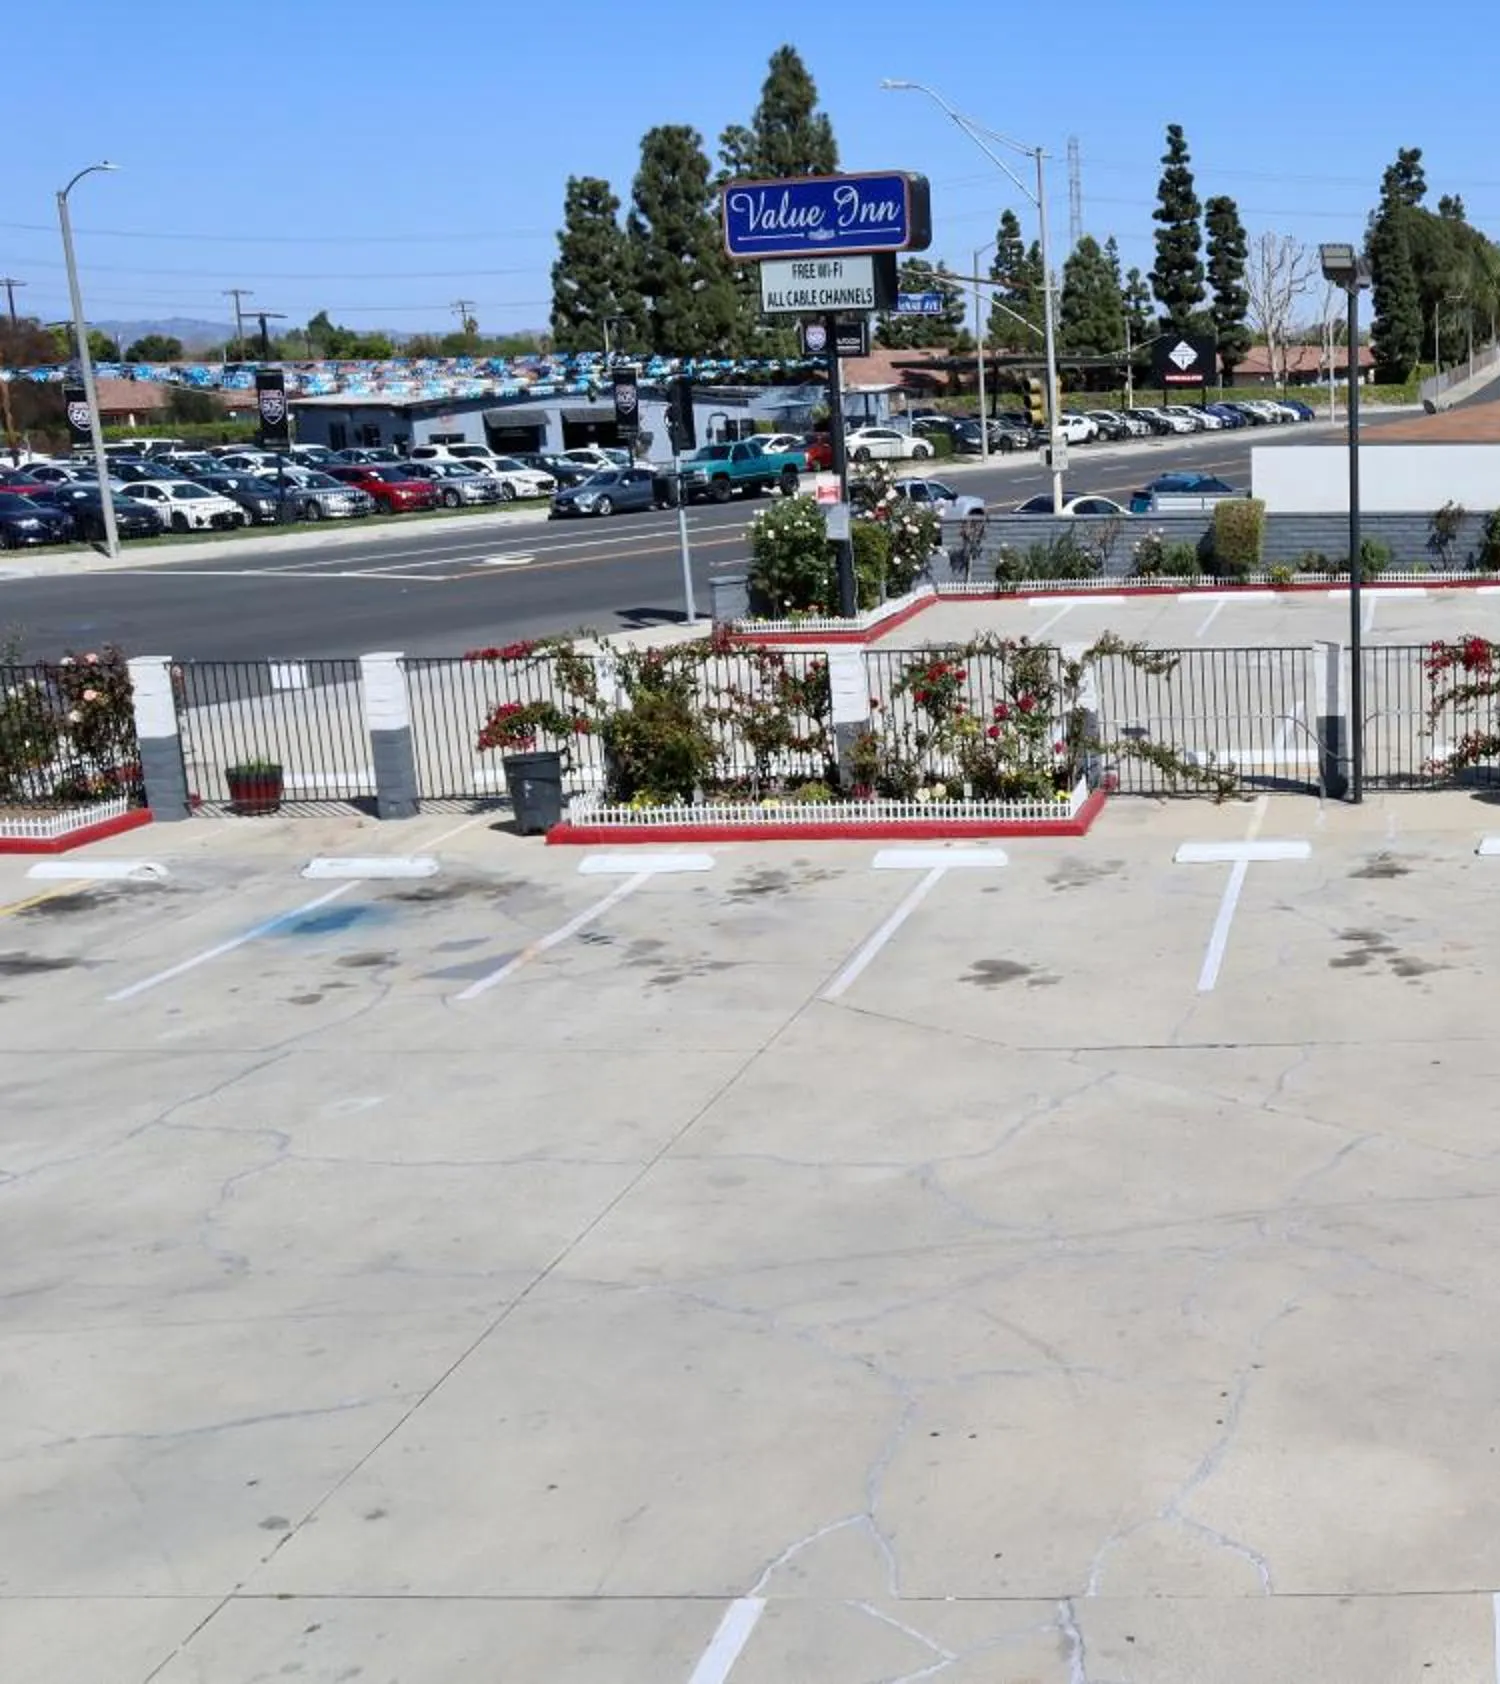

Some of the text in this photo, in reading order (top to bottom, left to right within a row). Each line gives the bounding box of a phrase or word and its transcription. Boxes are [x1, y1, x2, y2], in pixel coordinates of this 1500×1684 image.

[730, 185, 901, 233] Value Inn
[791, 263, 816, 280] FREE
[767, 287, 873, 307] ALL CABLE CHANNELS
